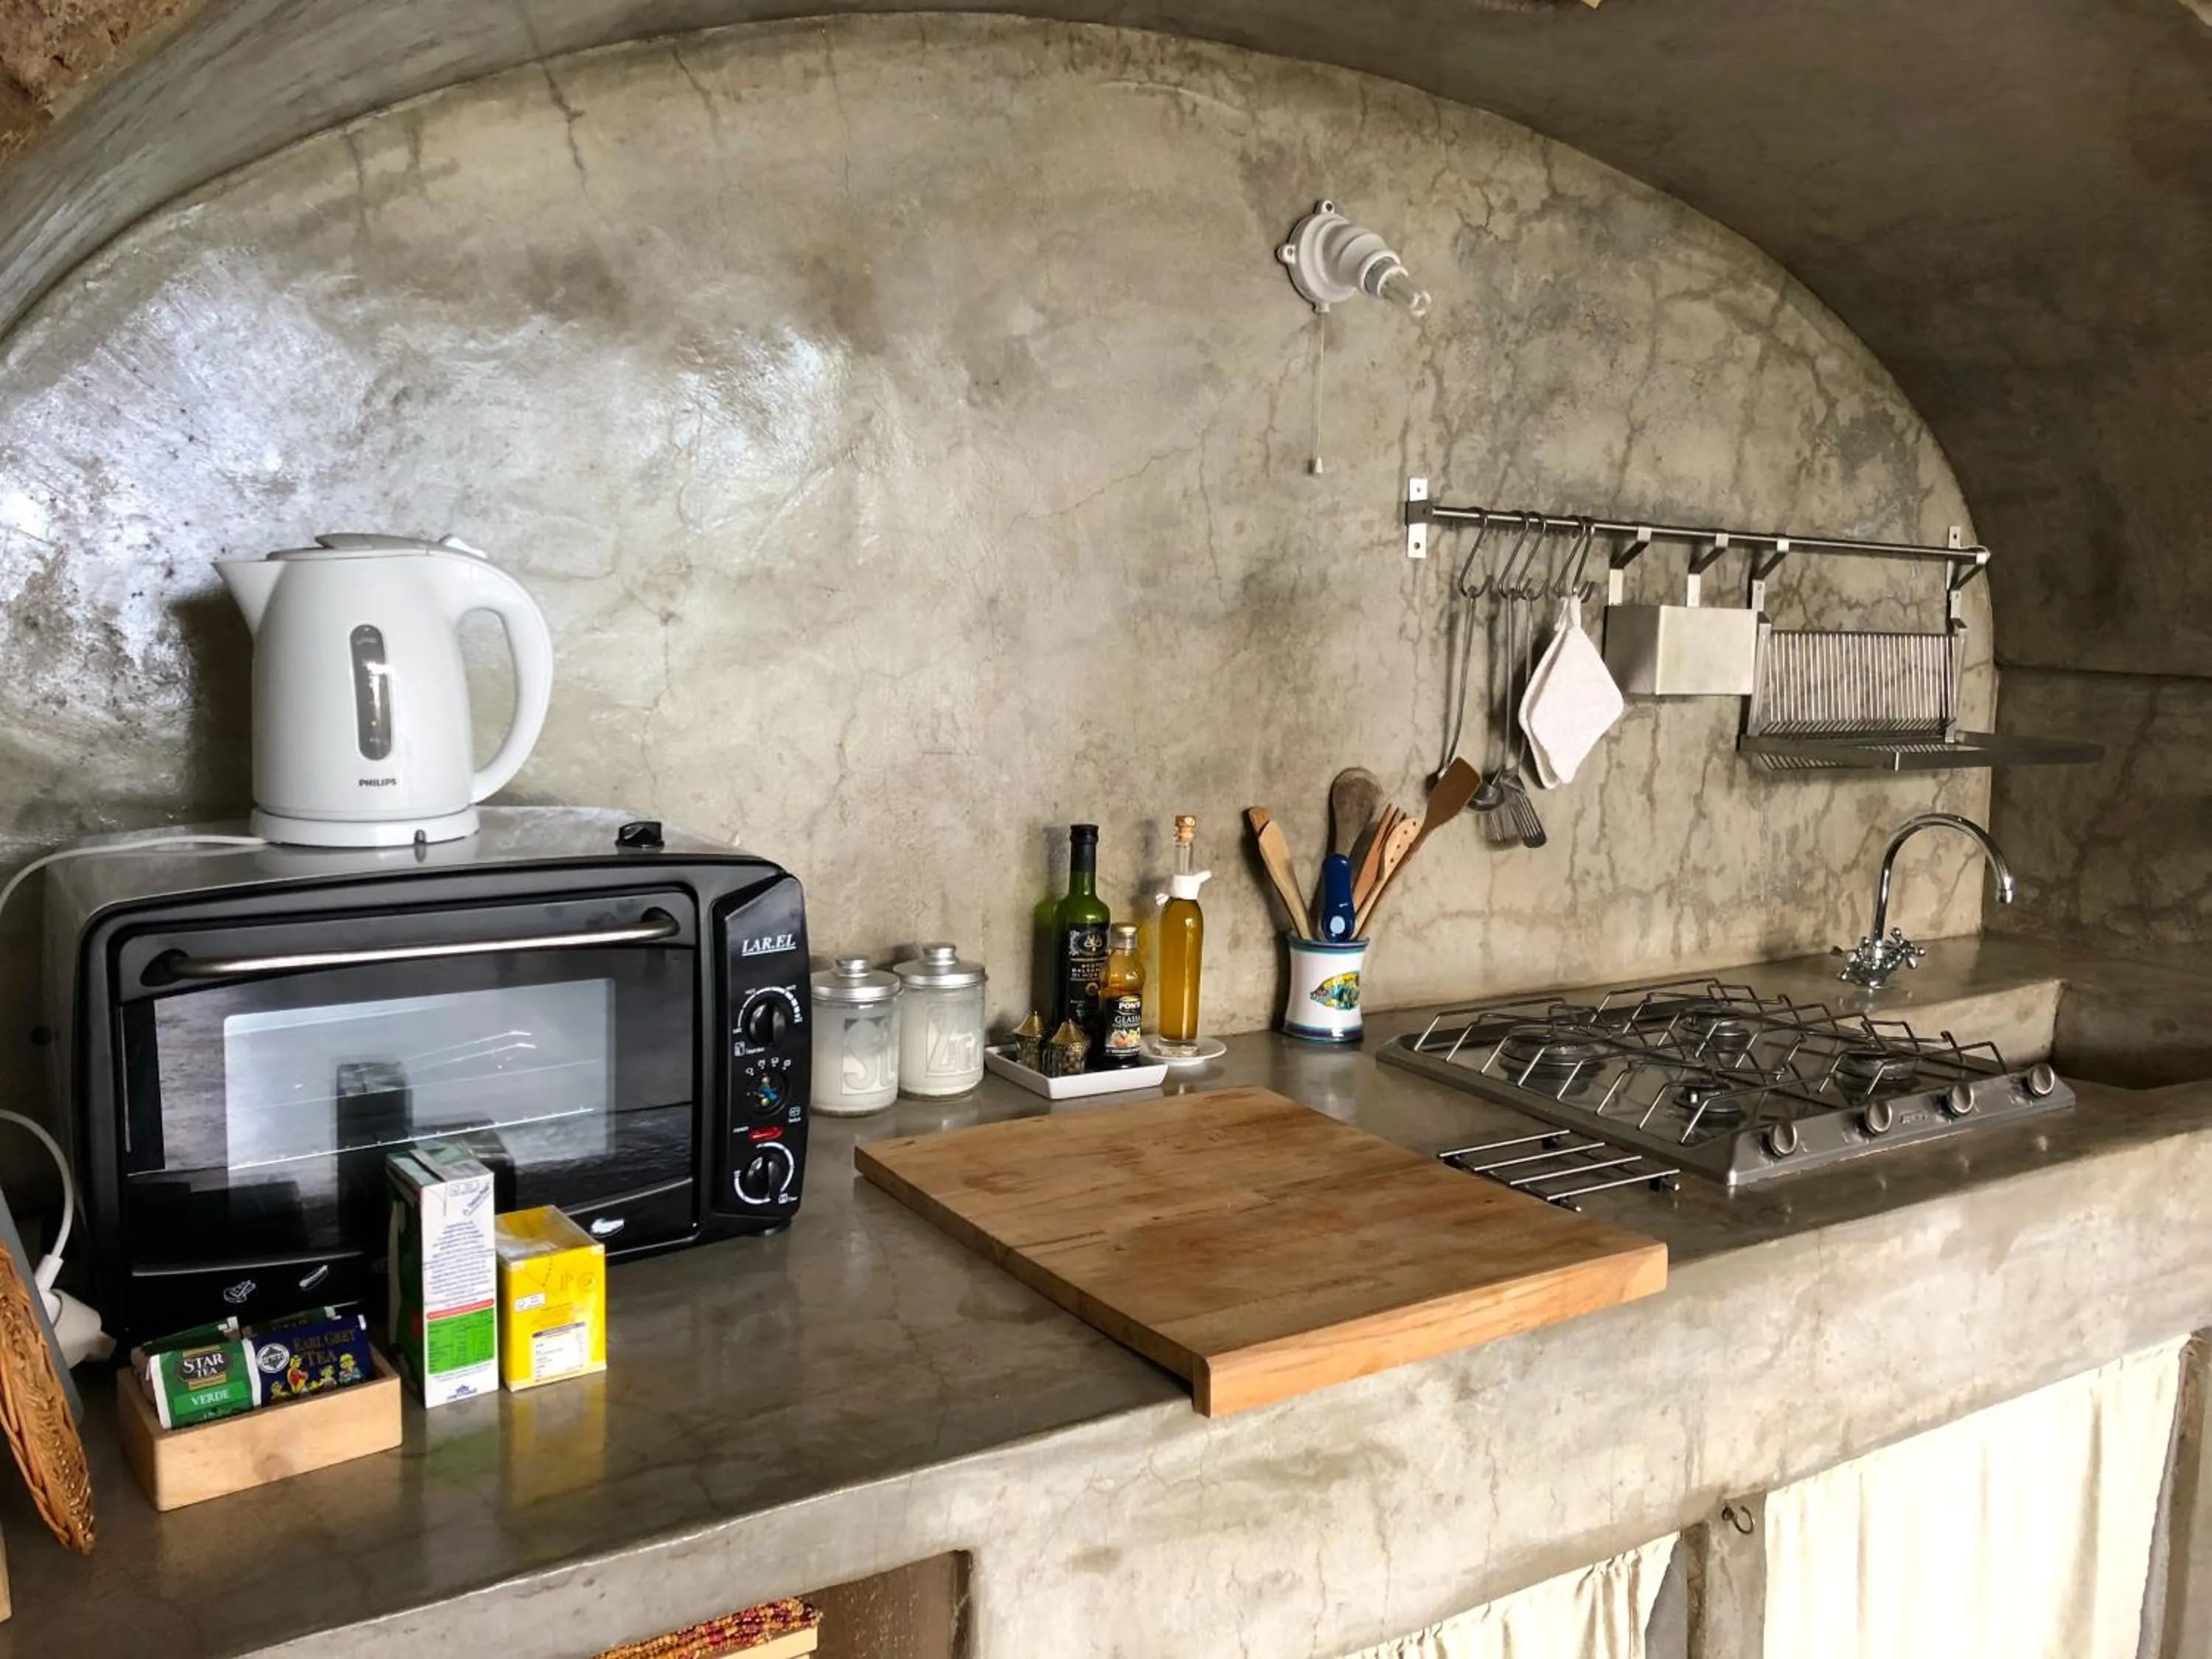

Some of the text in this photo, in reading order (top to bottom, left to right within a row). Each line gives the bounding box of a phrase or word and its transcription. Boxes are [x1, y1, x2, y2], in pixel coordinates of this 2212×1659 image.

[358, 778, 397, 787] PHILIPS
[184, 1354, 224, 1374] STAR
[303, 1348, 337, 1367] TEA
[197, 1368, 218, 1377] TEA
[192, 1389, 229, 1405] VERDE
